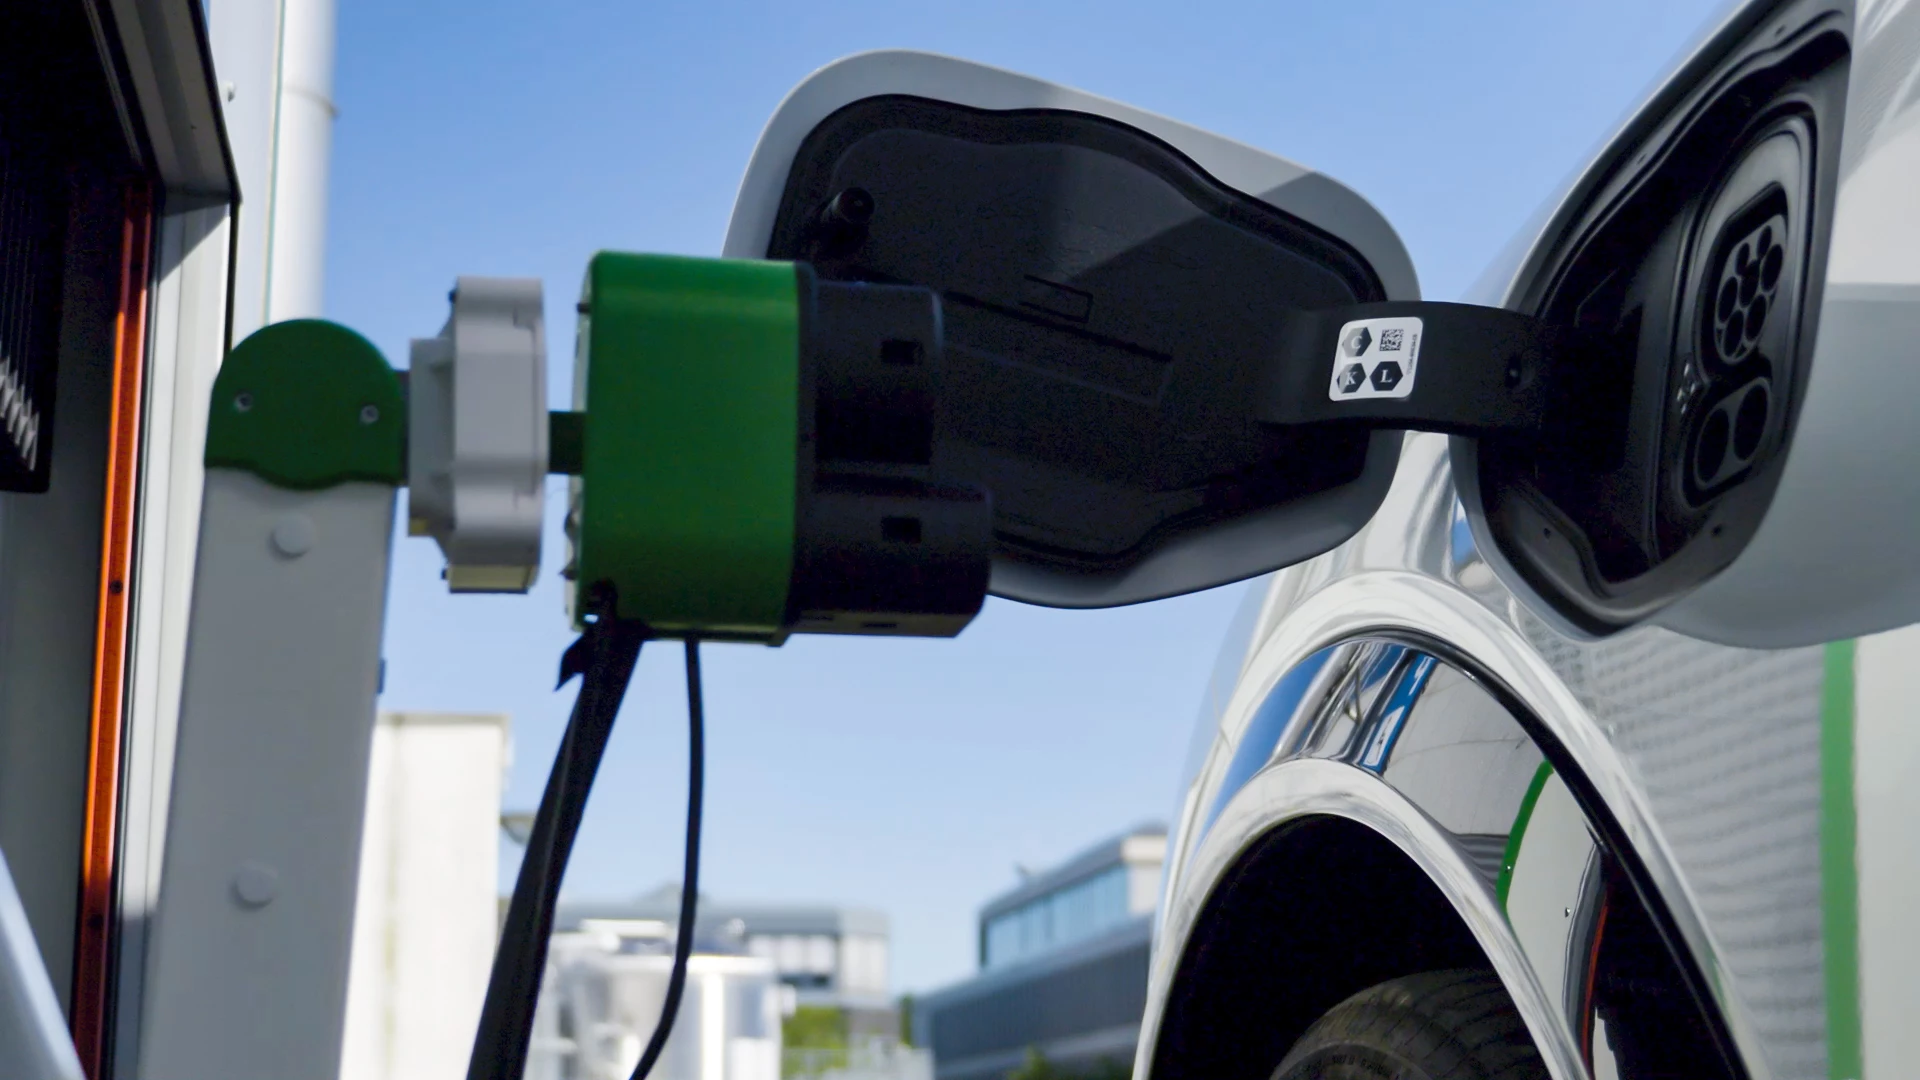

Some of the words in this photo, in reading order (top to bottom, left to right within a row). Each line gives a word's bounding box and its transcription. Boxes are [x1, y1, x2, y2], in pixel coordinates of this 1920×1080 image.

[1351, 336, 1363, 350] C
[1345, 371, 1358, 385] K
[1380, 369, 1392, 383] L
